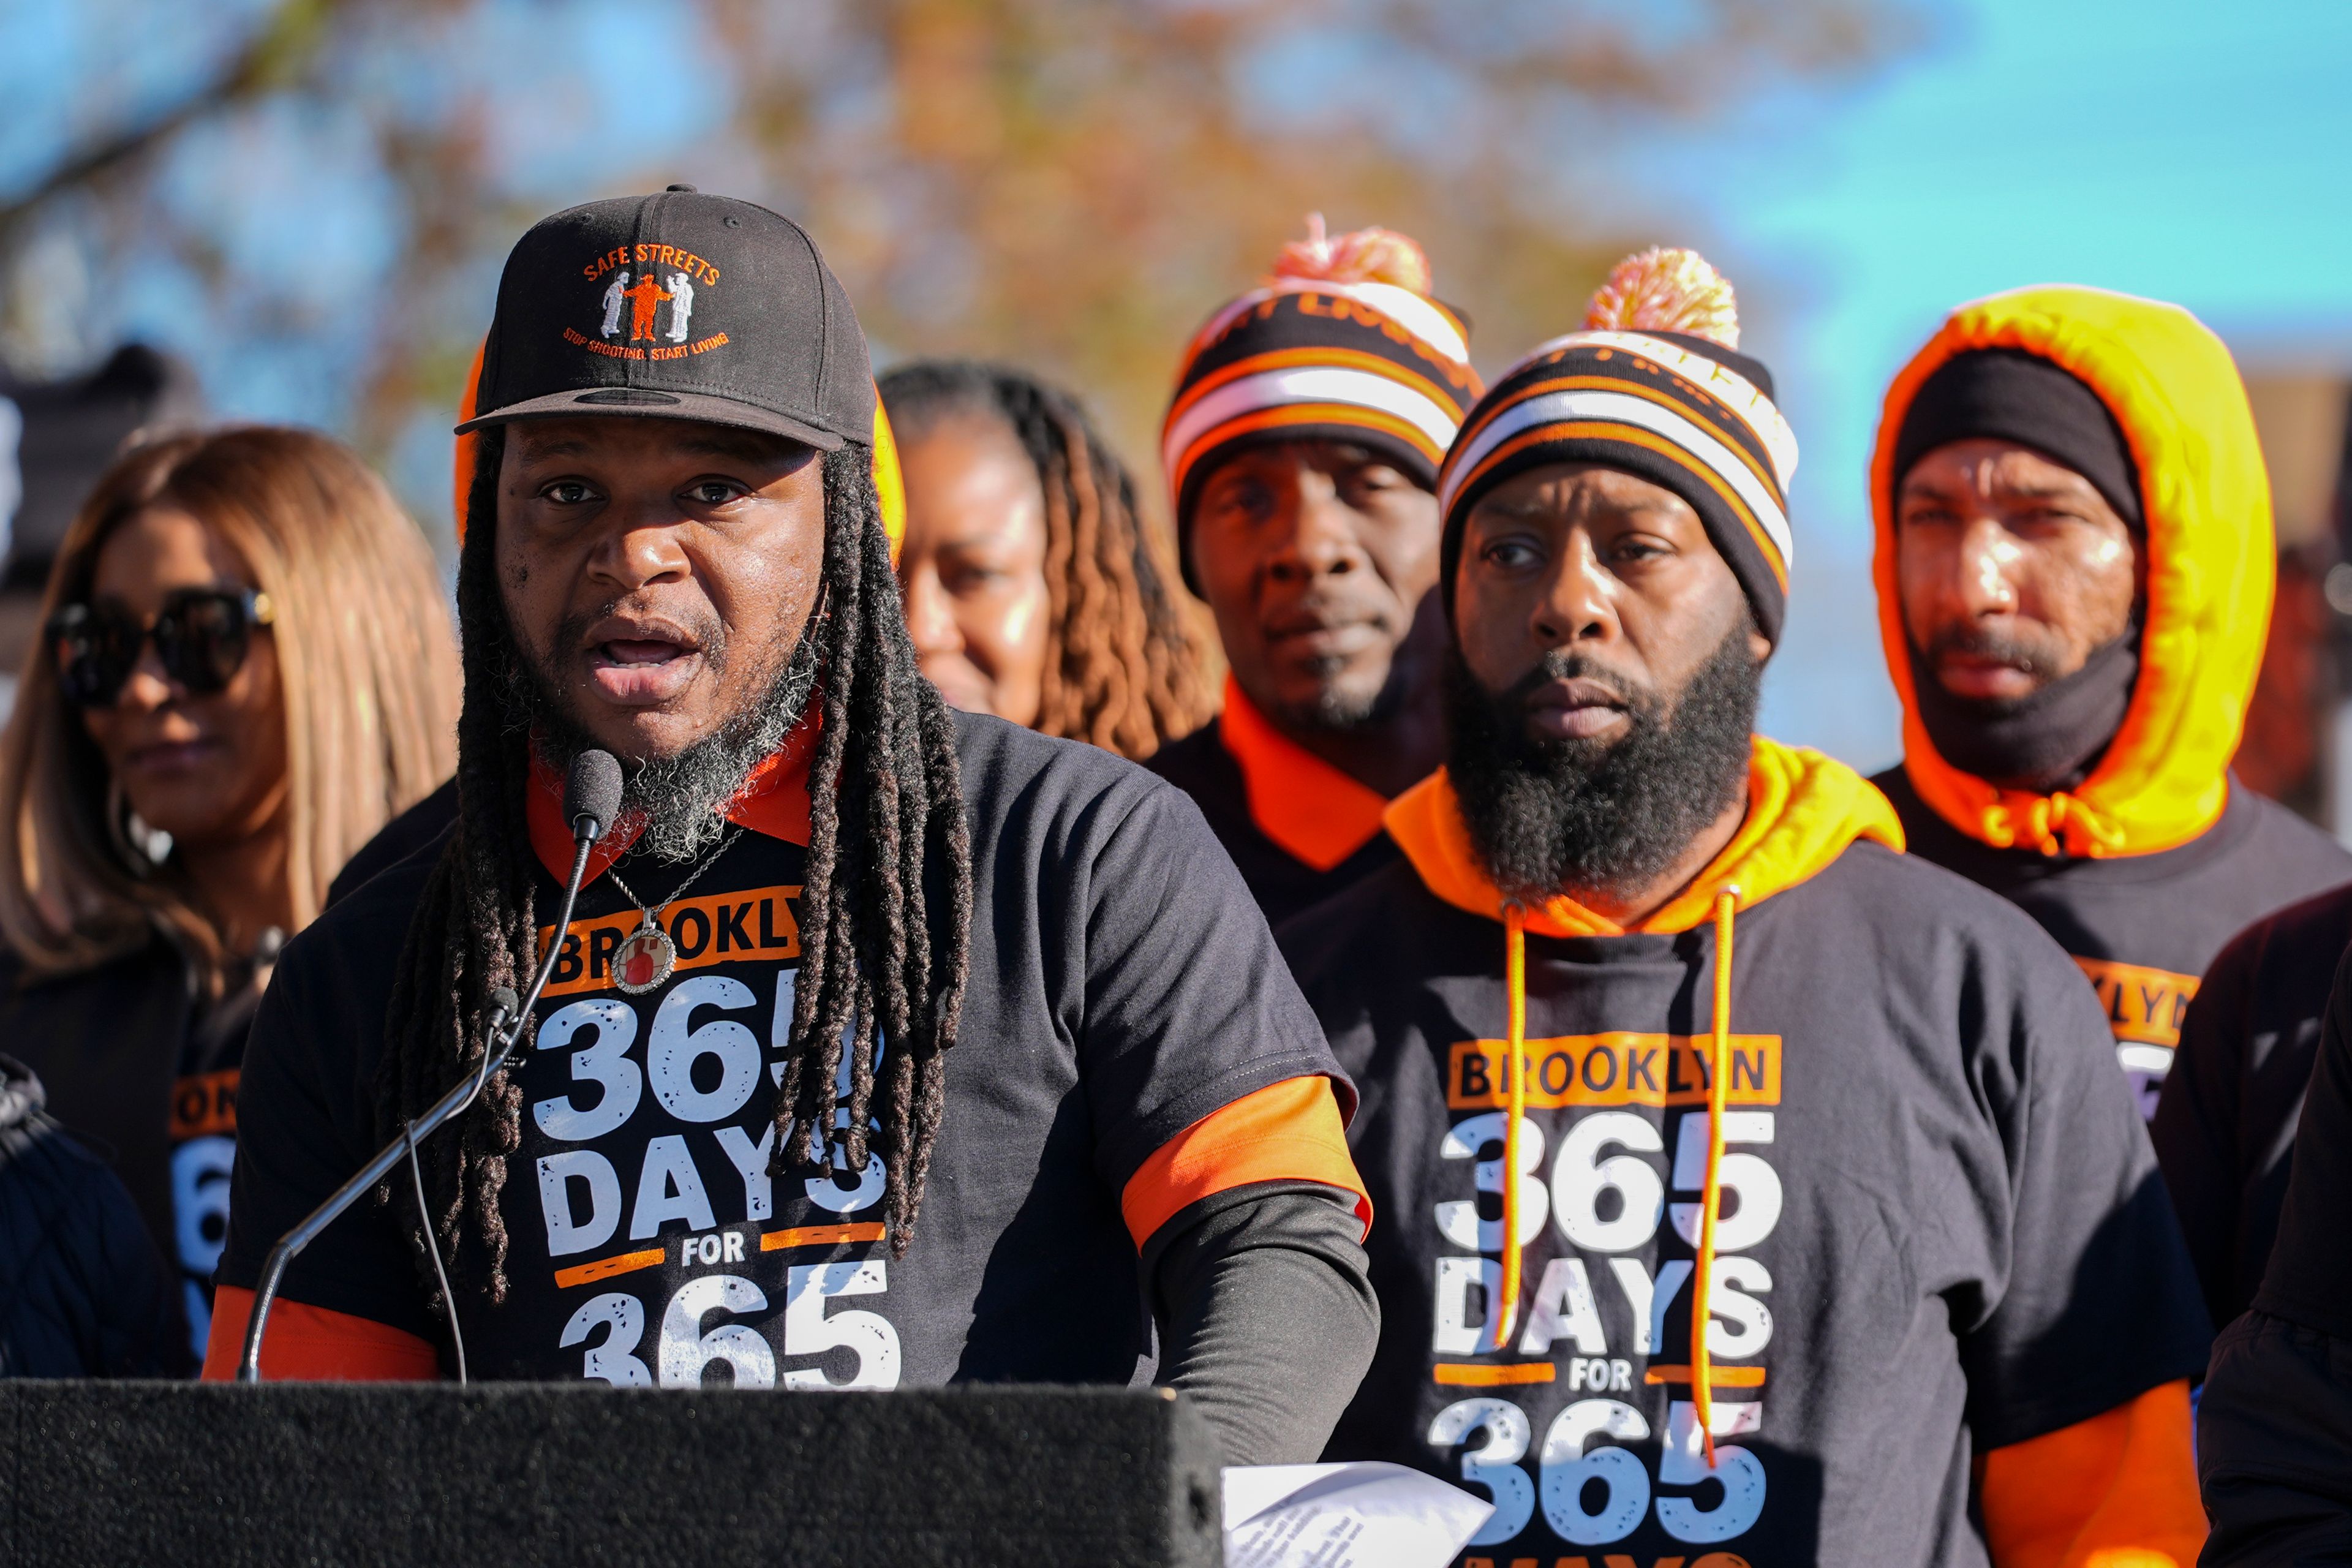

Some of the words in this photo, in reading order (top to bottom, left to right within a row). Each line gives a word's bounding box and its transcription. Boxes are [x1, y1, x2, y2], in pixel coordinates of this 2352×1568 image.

[584, 246, 630, 281] SAFE
[635, 244, 720, 286] STREETS
[563, 326, 587, 346] STOP
[651, 345, 688, 360] START
[690, 332, 729, 355] LIVING
[537, 1107, 886, 1256] DAYS
[1434, 1110, 1782, 1253] 365
[682, 1231, 745, 1267] FOR
[559, 1259, 901, 1392] 365
[1433, 1256, 1774, 1359] DAYS
[1569, 1358, 1632, 1392] FOR
[1427, 1397, 1767, 1547] 365
